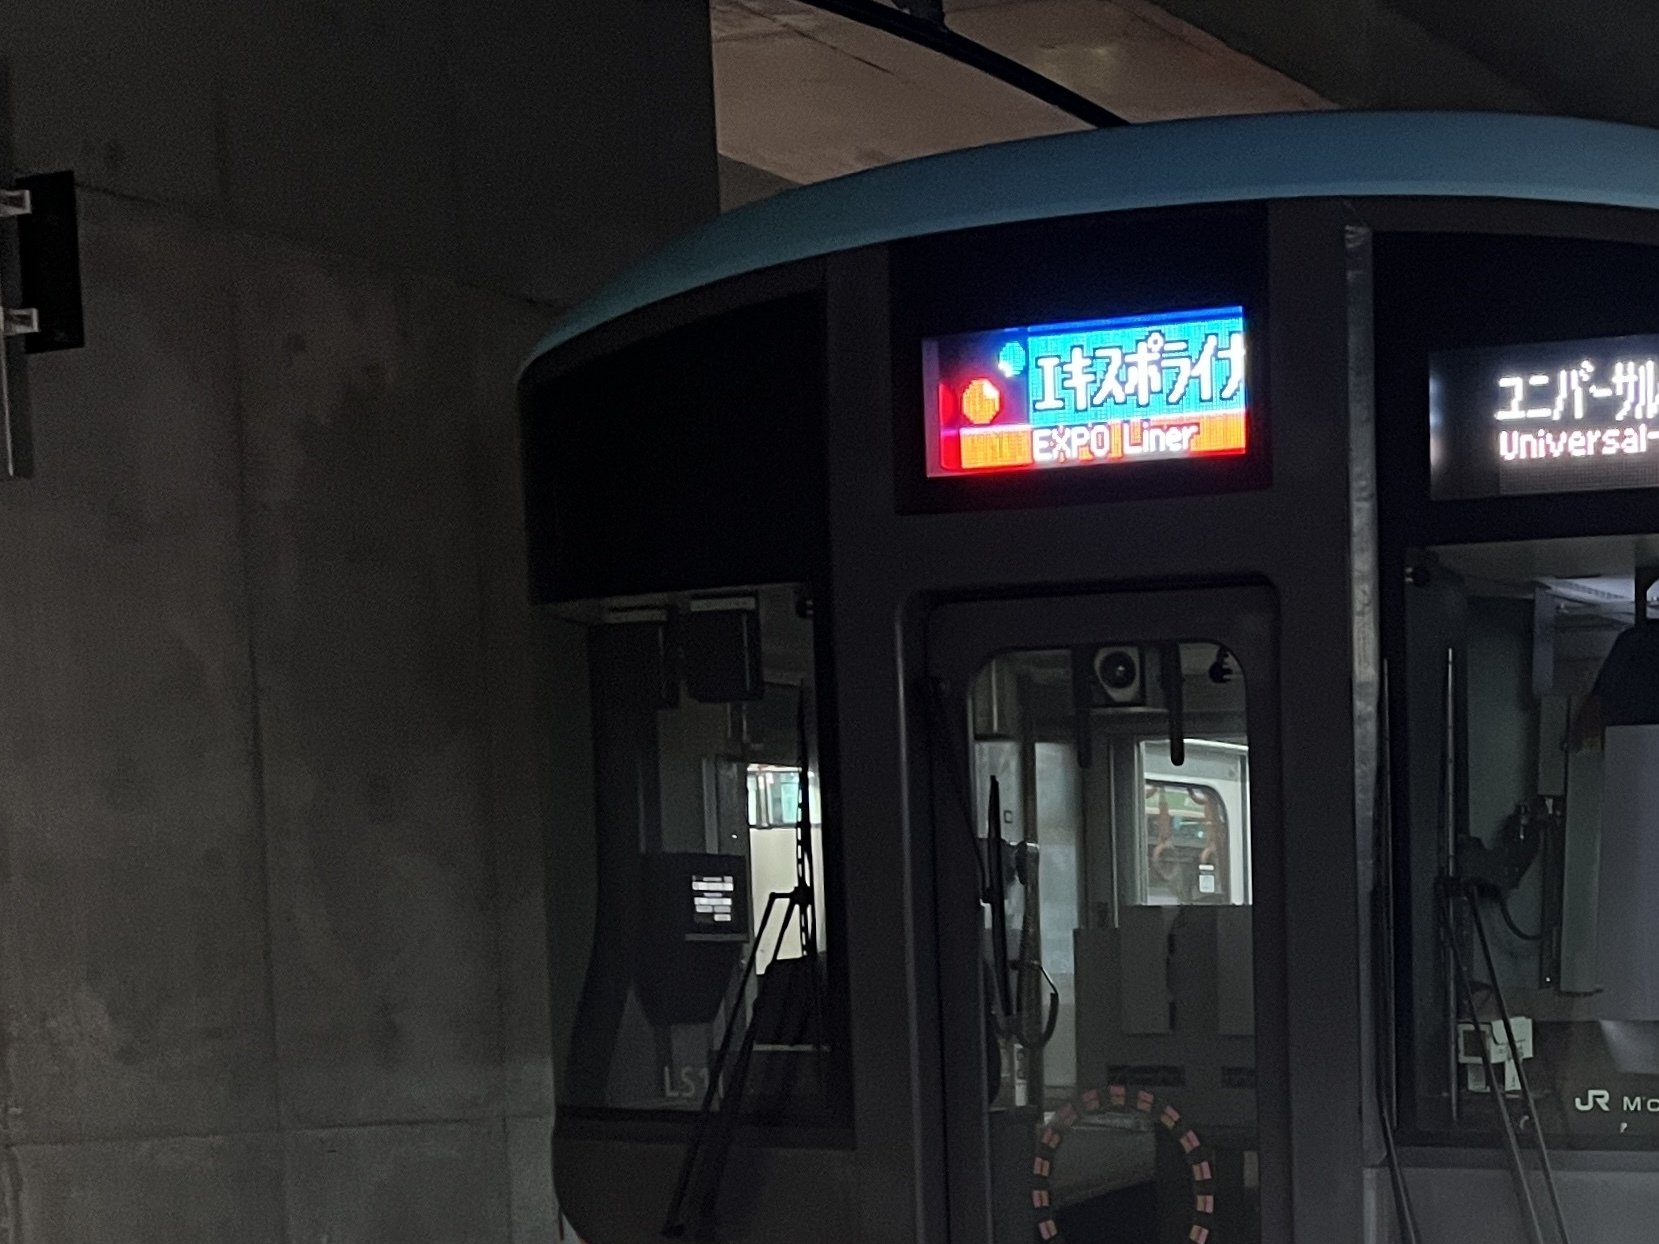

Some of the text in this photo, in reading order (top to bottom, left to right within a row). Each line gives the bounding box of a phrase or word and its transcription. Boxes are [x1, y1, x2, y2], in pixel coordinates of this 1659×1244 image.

[1032, 421, 1199, 461] EXPO Liner
[1574, 1089, 1610, 1112] JR
